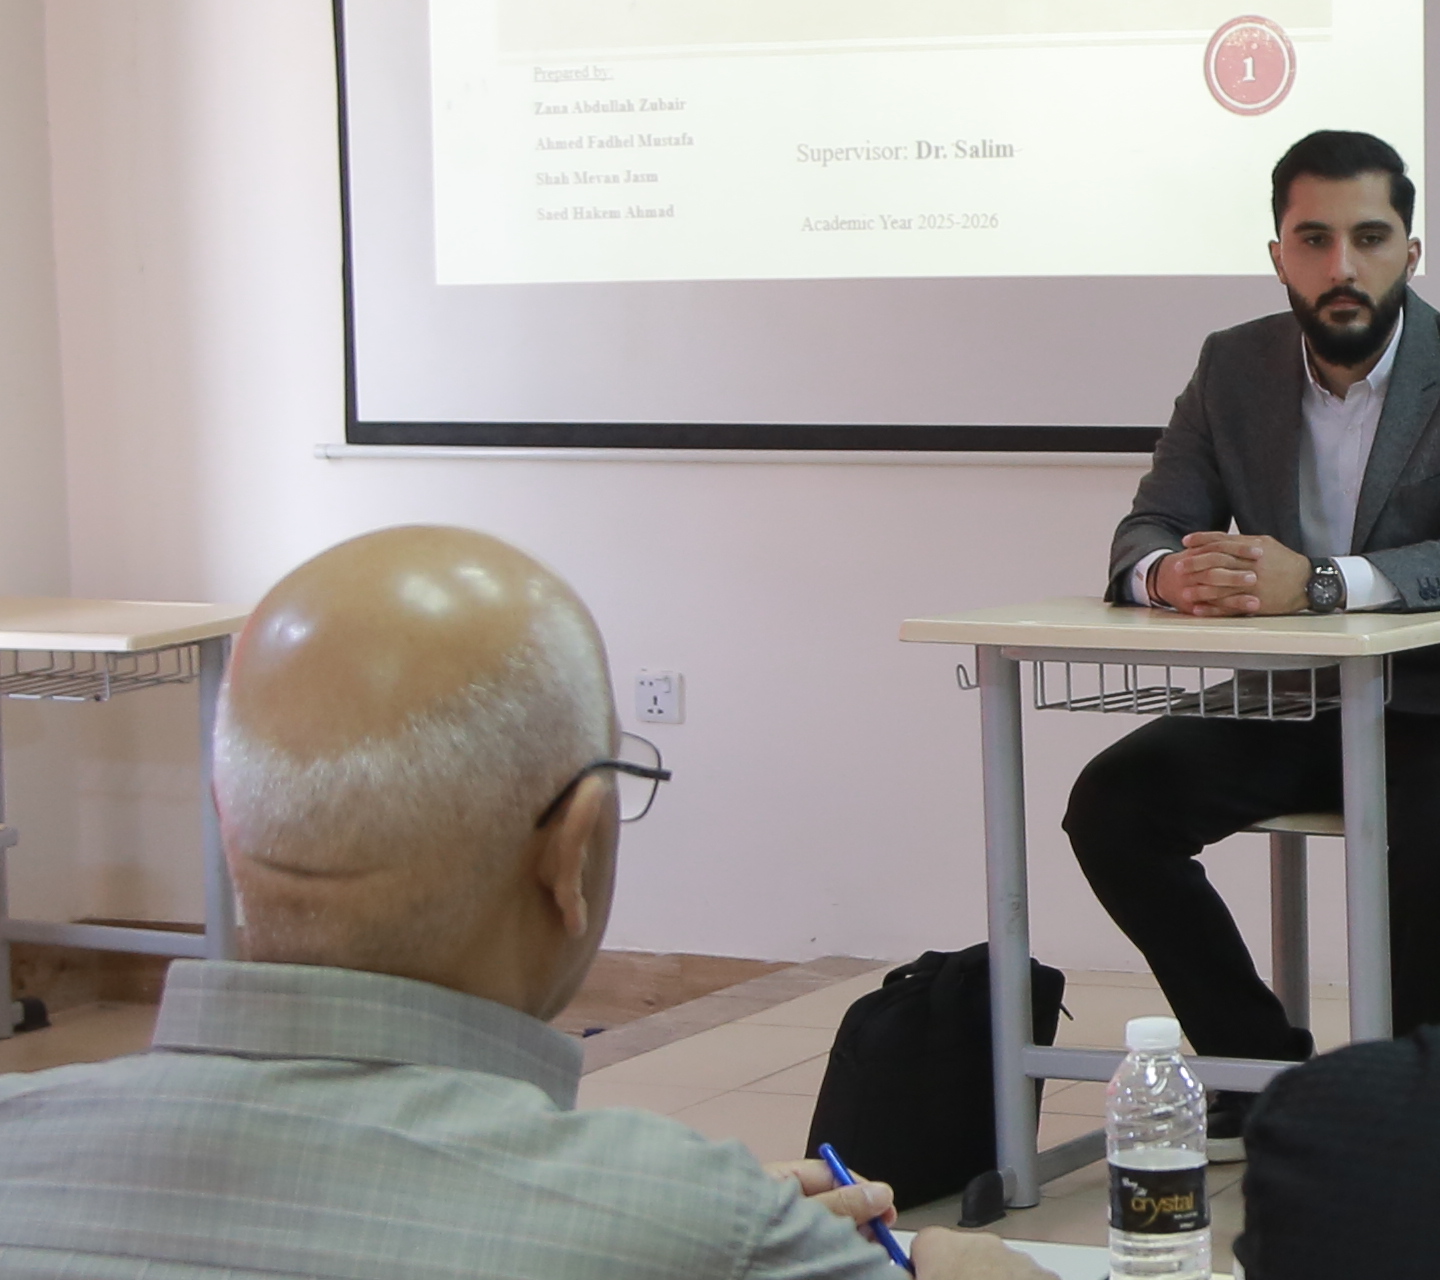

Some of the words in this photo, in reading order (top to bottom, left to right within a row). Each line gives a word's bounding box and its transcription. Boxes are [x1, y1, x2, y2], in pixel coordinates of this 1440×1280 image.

[533, 65, 589, 83] Prepared
[1242, 56, 1256, 82] 1
[534, 101, 569, 116] Zana
[572, 98, 635, 114] Abdullah
[639, 97, 687, 113] Zubair
[535, 136, 583, 151] Ahmed
[587, 134, 634, 150] Fadhel
[637, 132, 695, 148] Mustafa
[796, 139, 908, 167] Supervisor:
[915, 140, 948, 160] Dr.
[954, 138, 1015, 159] Salim
[536, 172, 570, 186] Shah
[573, 170, 620, 185] Mevan
[537, 207, 569, 221] Saed
[573, 205, 621, 220] Hakem
[625, 203, 675, 219] Ahmad
[801, 215, 875, 231] Academic
[879, 214, 913, 230] Year
[917, 213, 999, 230] 2025-2026
[1131, 1191, 1194, 1228] crystal
